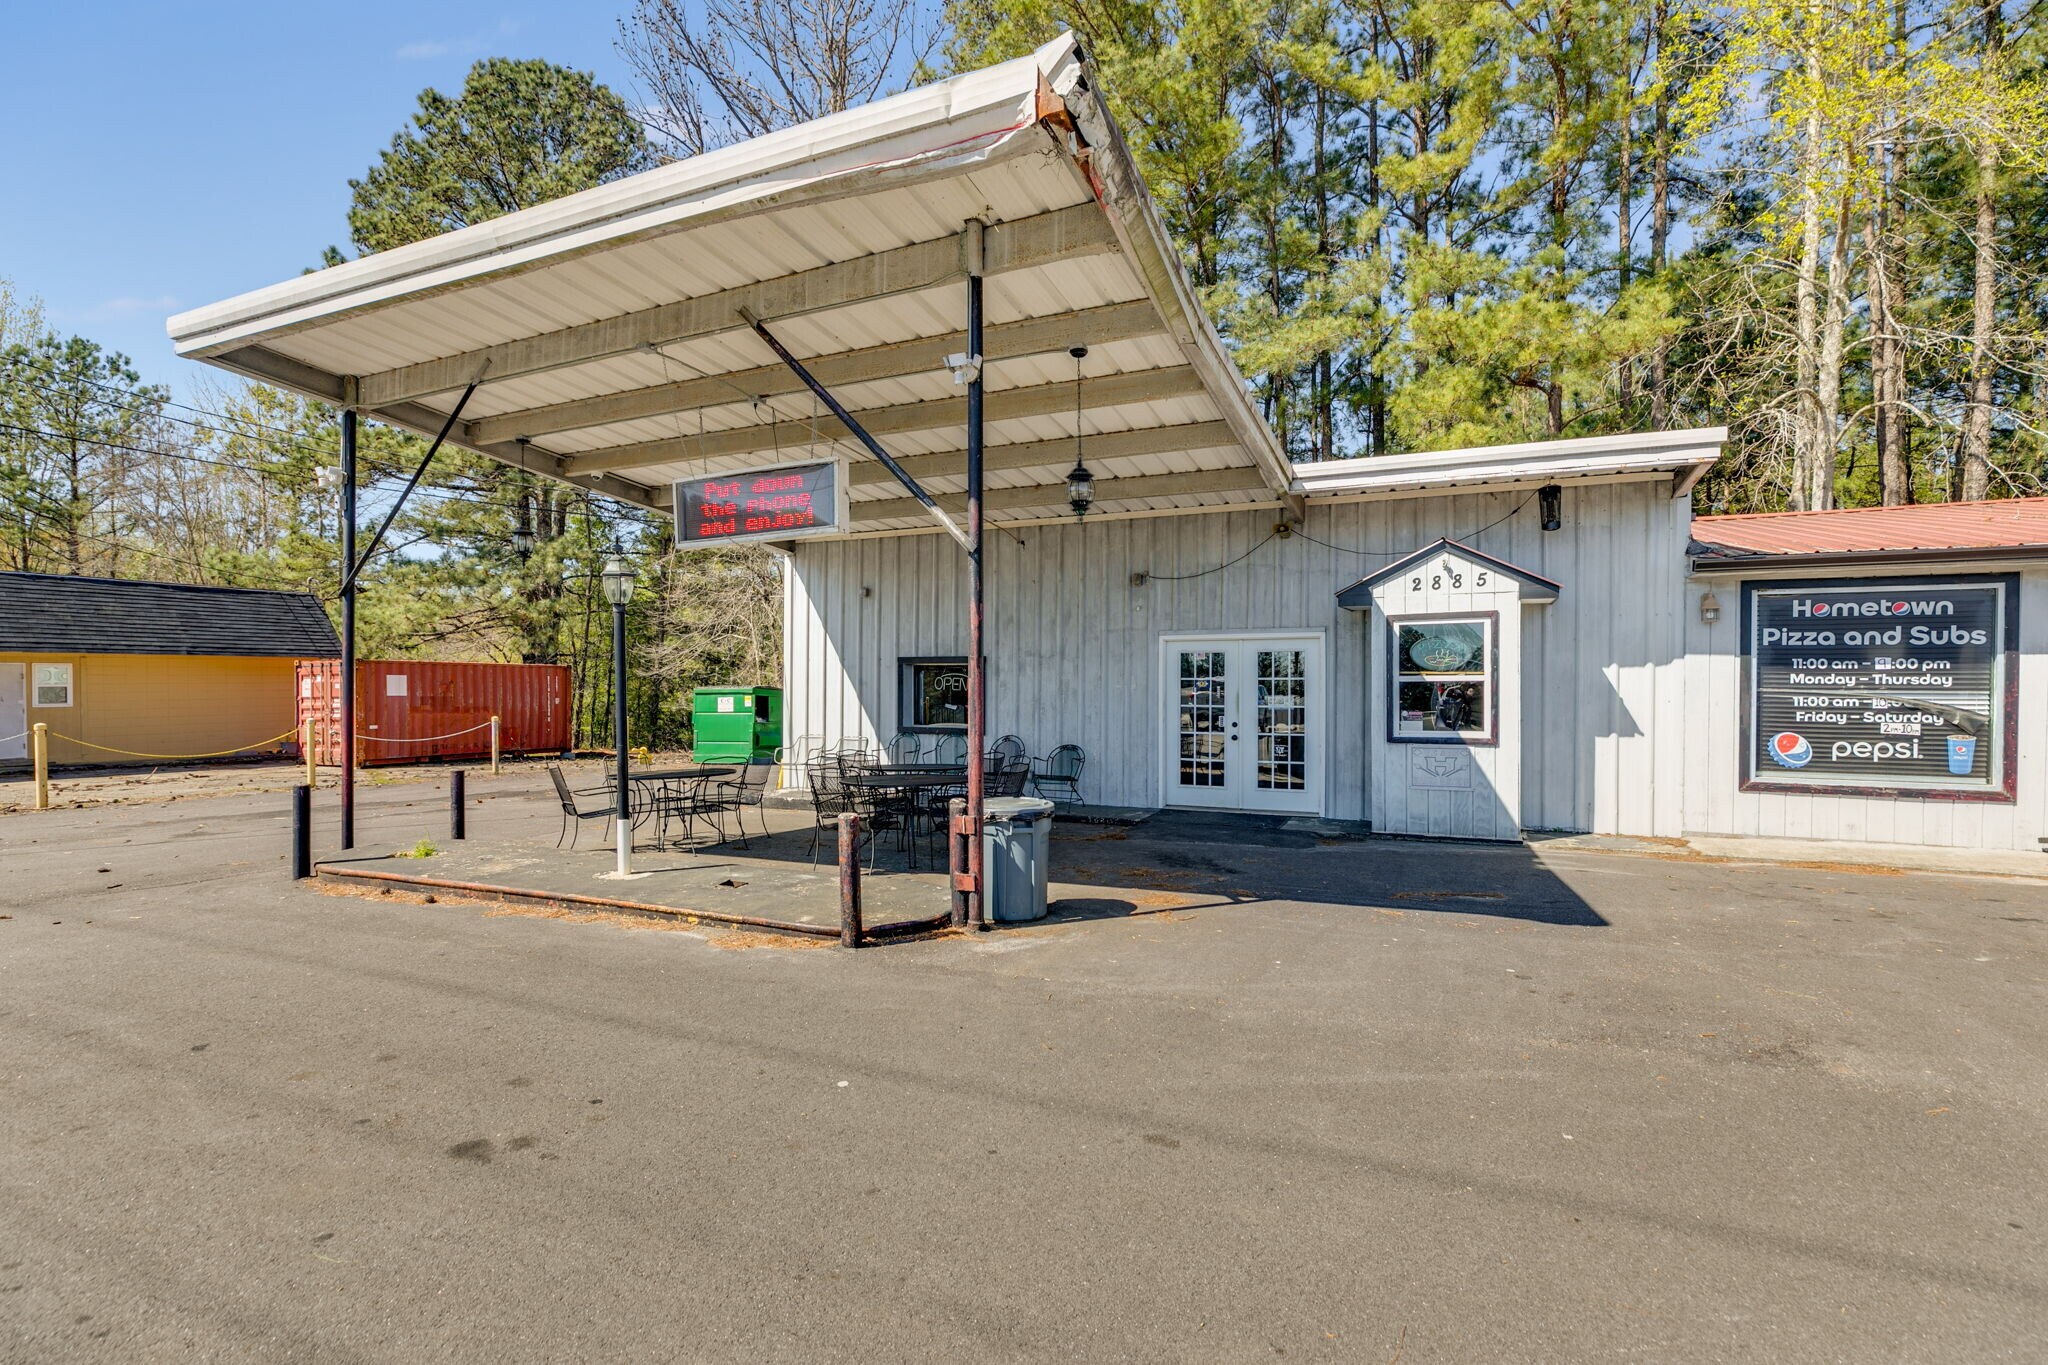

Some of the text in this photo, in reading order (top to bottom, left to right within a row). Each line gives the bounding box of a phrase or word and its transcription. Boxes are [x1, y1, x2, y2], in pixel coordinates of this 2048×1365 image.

[704, 475, 803, 500] Put down
[700, 502, 737, 517] the
[699, 518, 736, 537] and
[1412, 572, 1488, 592] 2885
[1792, 600, 1954, 618] Hometown
[1762, 624, 1988, 646] Pizza and Subs
[1792, 658, 1828, 670] 11:00
[1831, 660, 1859, 670] am
[1922, 660, 1950, 672] pm
[934, 676, 968, 692] OPEN
[1789, 673, 1856, 687] Monday
[1872, 674, 1953, 688] Thursday
[1792, 696, 1829, 707] 11:00
[1832, 698, 1859, 708] am
[1795, 711, 1847, 725] Friday
[1863, 711, 1944, 726] Saturday
